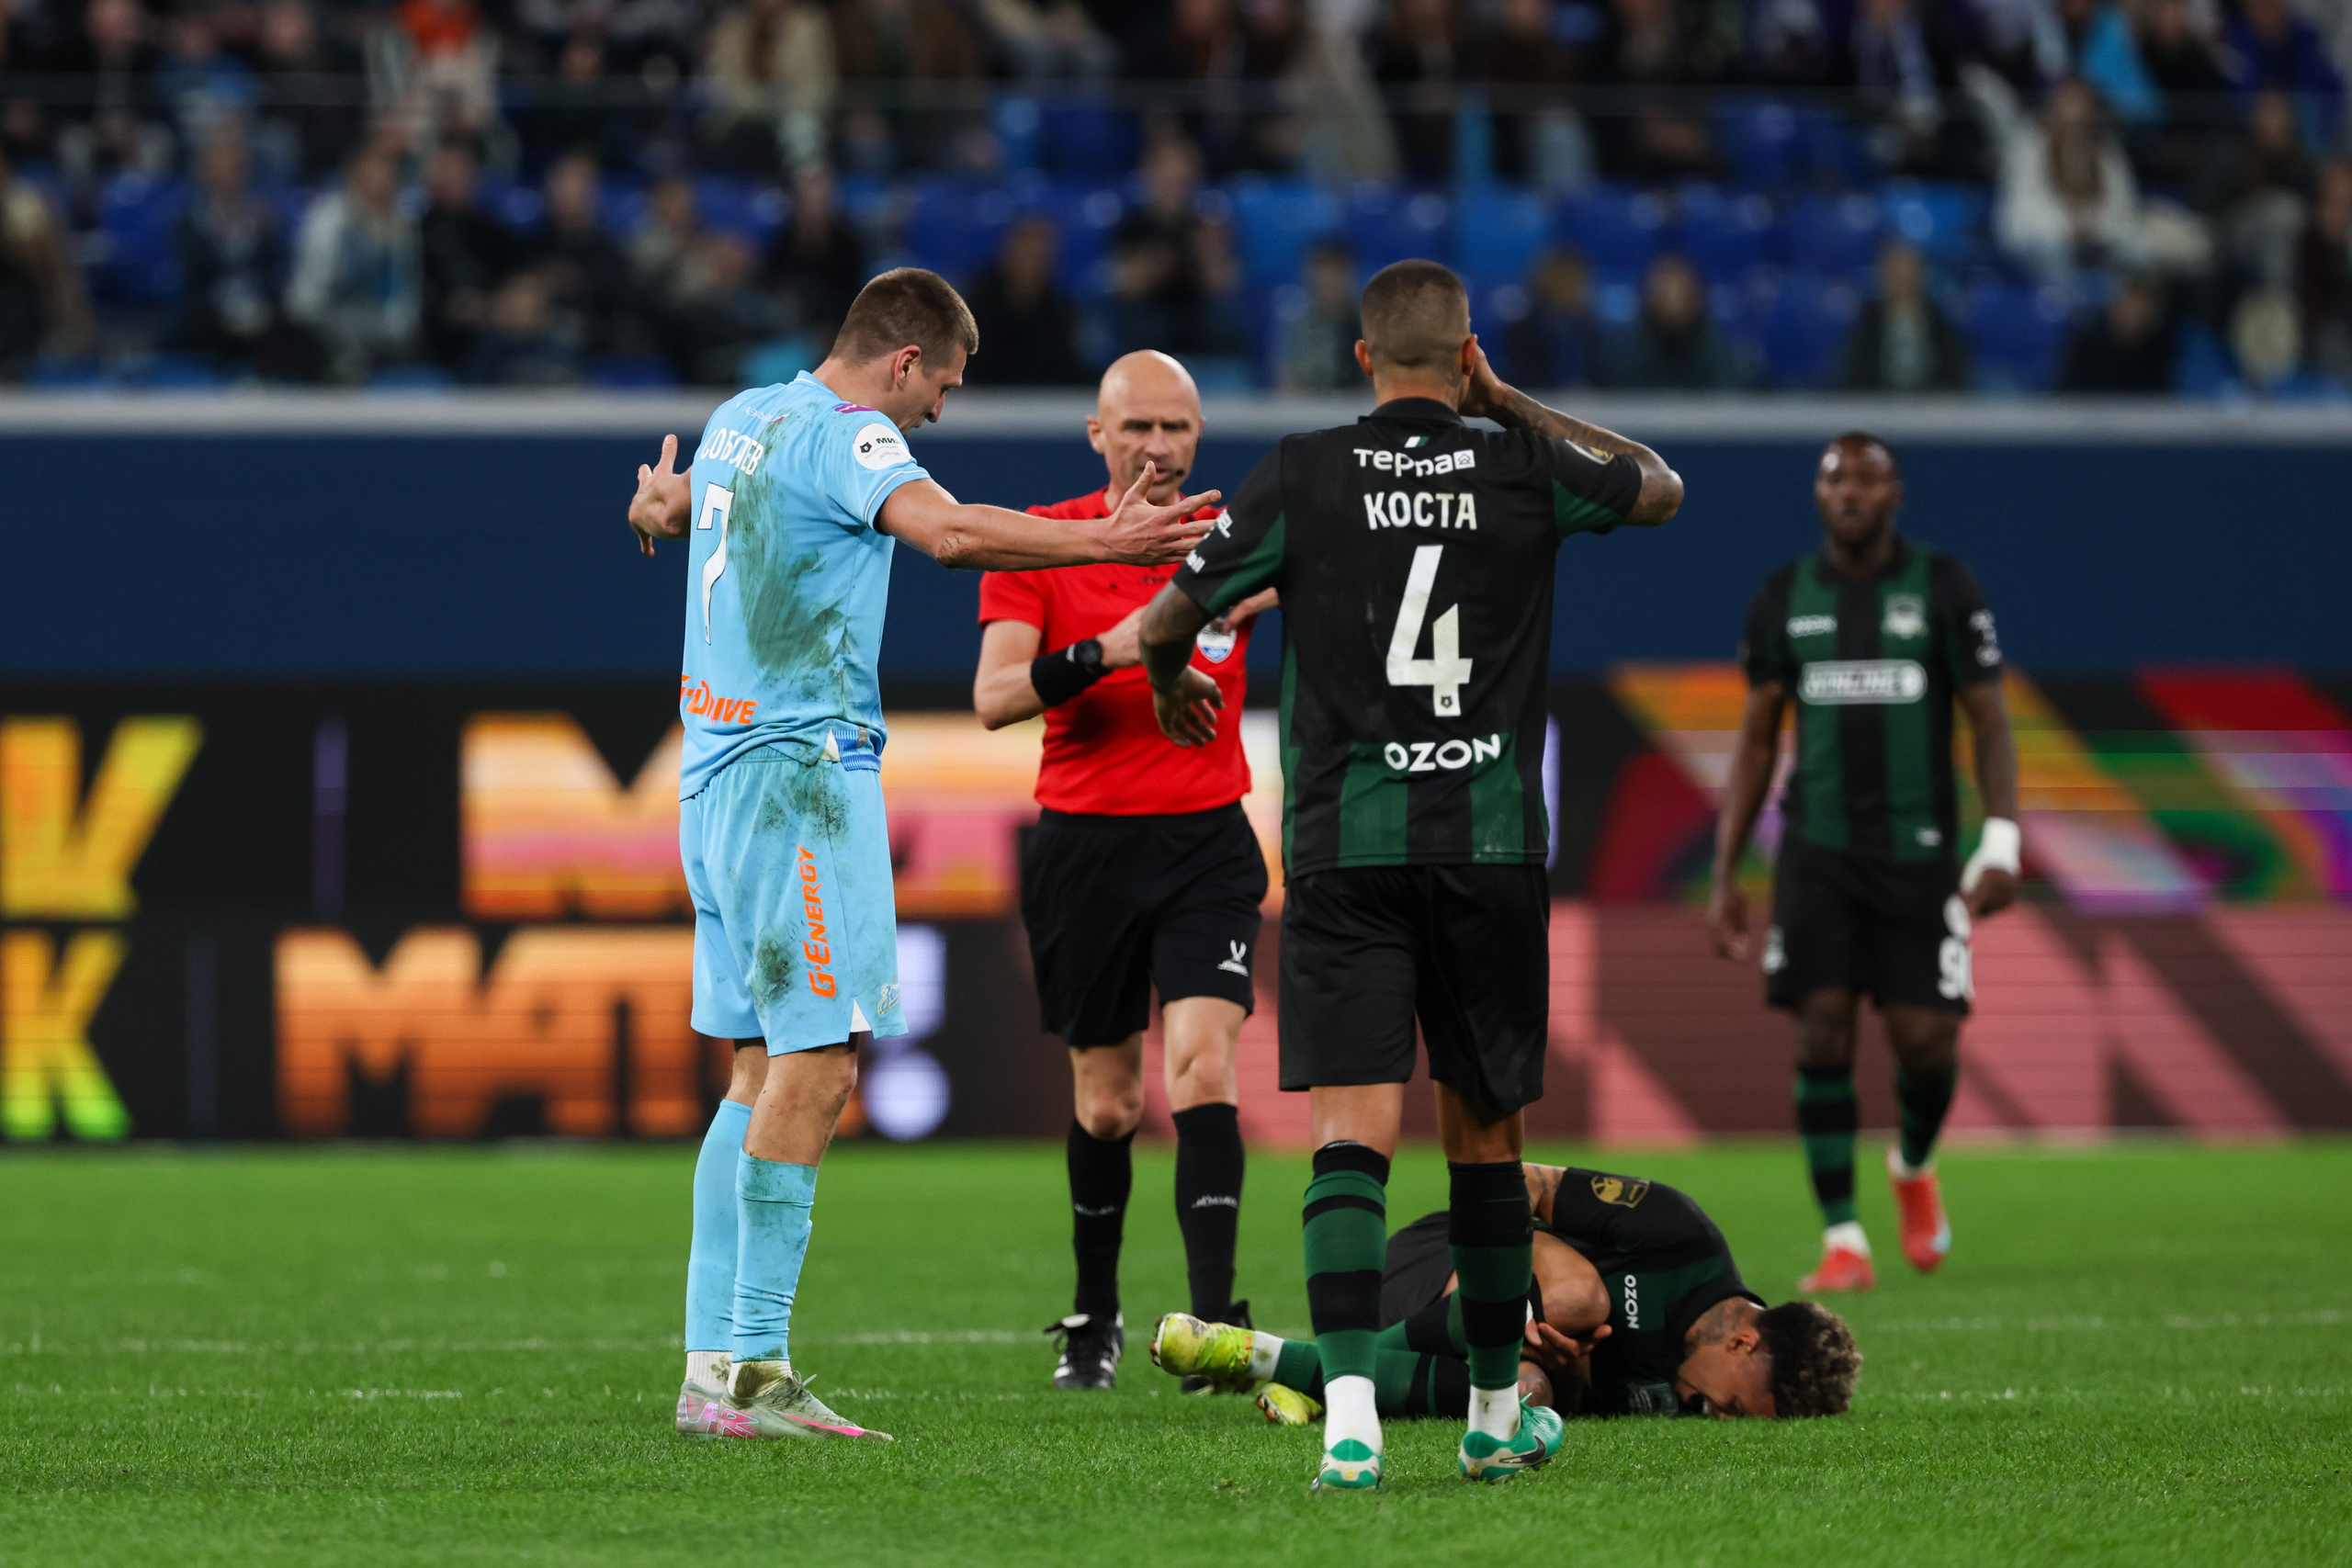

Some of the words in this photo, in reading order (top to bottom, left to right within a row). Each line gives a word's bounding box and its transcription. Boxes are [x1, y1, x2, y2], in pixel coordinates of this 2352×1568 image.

[1363, 491, 1478, 531] КОСТА
[696, 482, 734, 645] 7
[1385, 544, 1474, 717] 4
[1385, 733, 1502, 773] OZON
[1623, 1273, 1640, 1329] OZON
